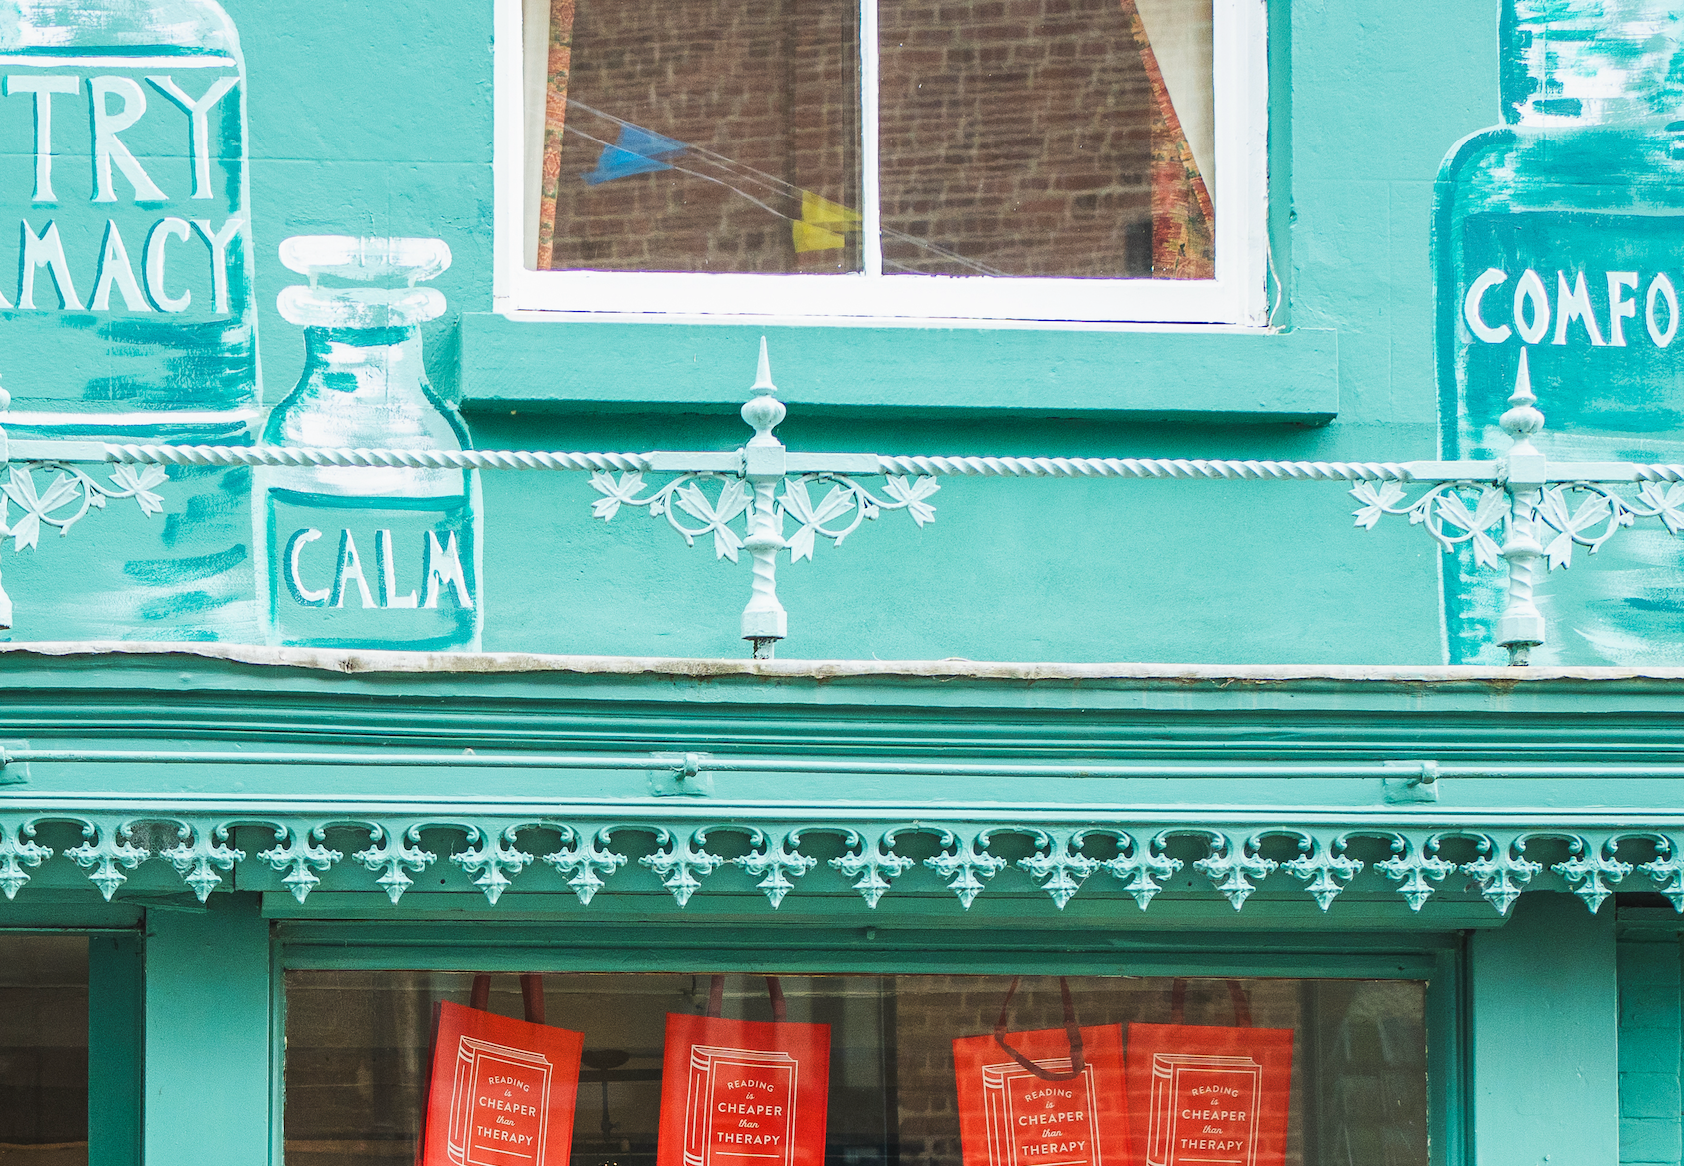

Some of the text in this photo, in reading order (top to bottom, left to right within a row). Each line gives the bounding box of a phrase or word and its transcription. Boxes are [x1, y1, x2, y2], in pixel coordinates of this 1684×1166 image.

[1464, 267, 1680, 348] COMFO
[284, 527, 475, 609] CALM
[488, 1074, 530, 1092] READING
[727, 1079, 775, 1092] READING
[504, 1089, 512, 1098] is
[746, 1092, 754, 1100] is
[1025, 1088, 1073, 1102] READING
[1191, 1084, 1239, 1097] READING
[479, 1096, 536, 1117] CHEAPER
[1046, 1100, 1054, 1109] is
[1211, 1097, 1219, 1106] is
[718, 1103, 783, 1117] CHEAPER
[1182, 1109, 1246, 1122] CHEAPER
[496, 1115, 515, 1126] than
[739, 1119, 759, 1129] than
[1018, 1111, 1084, 1126] CHEAPER
[477, 1126, 533, 1146] THERAPY
[1042, 1128, 1063, 1138] than
[1203, 1125, 1223, 1135] than
[717, 1132, 780, 1146] THERAPY
[1181, 1139, 1244, 1151] THERAPY
[1022, 1141, 1086, 1156] THERAPY
